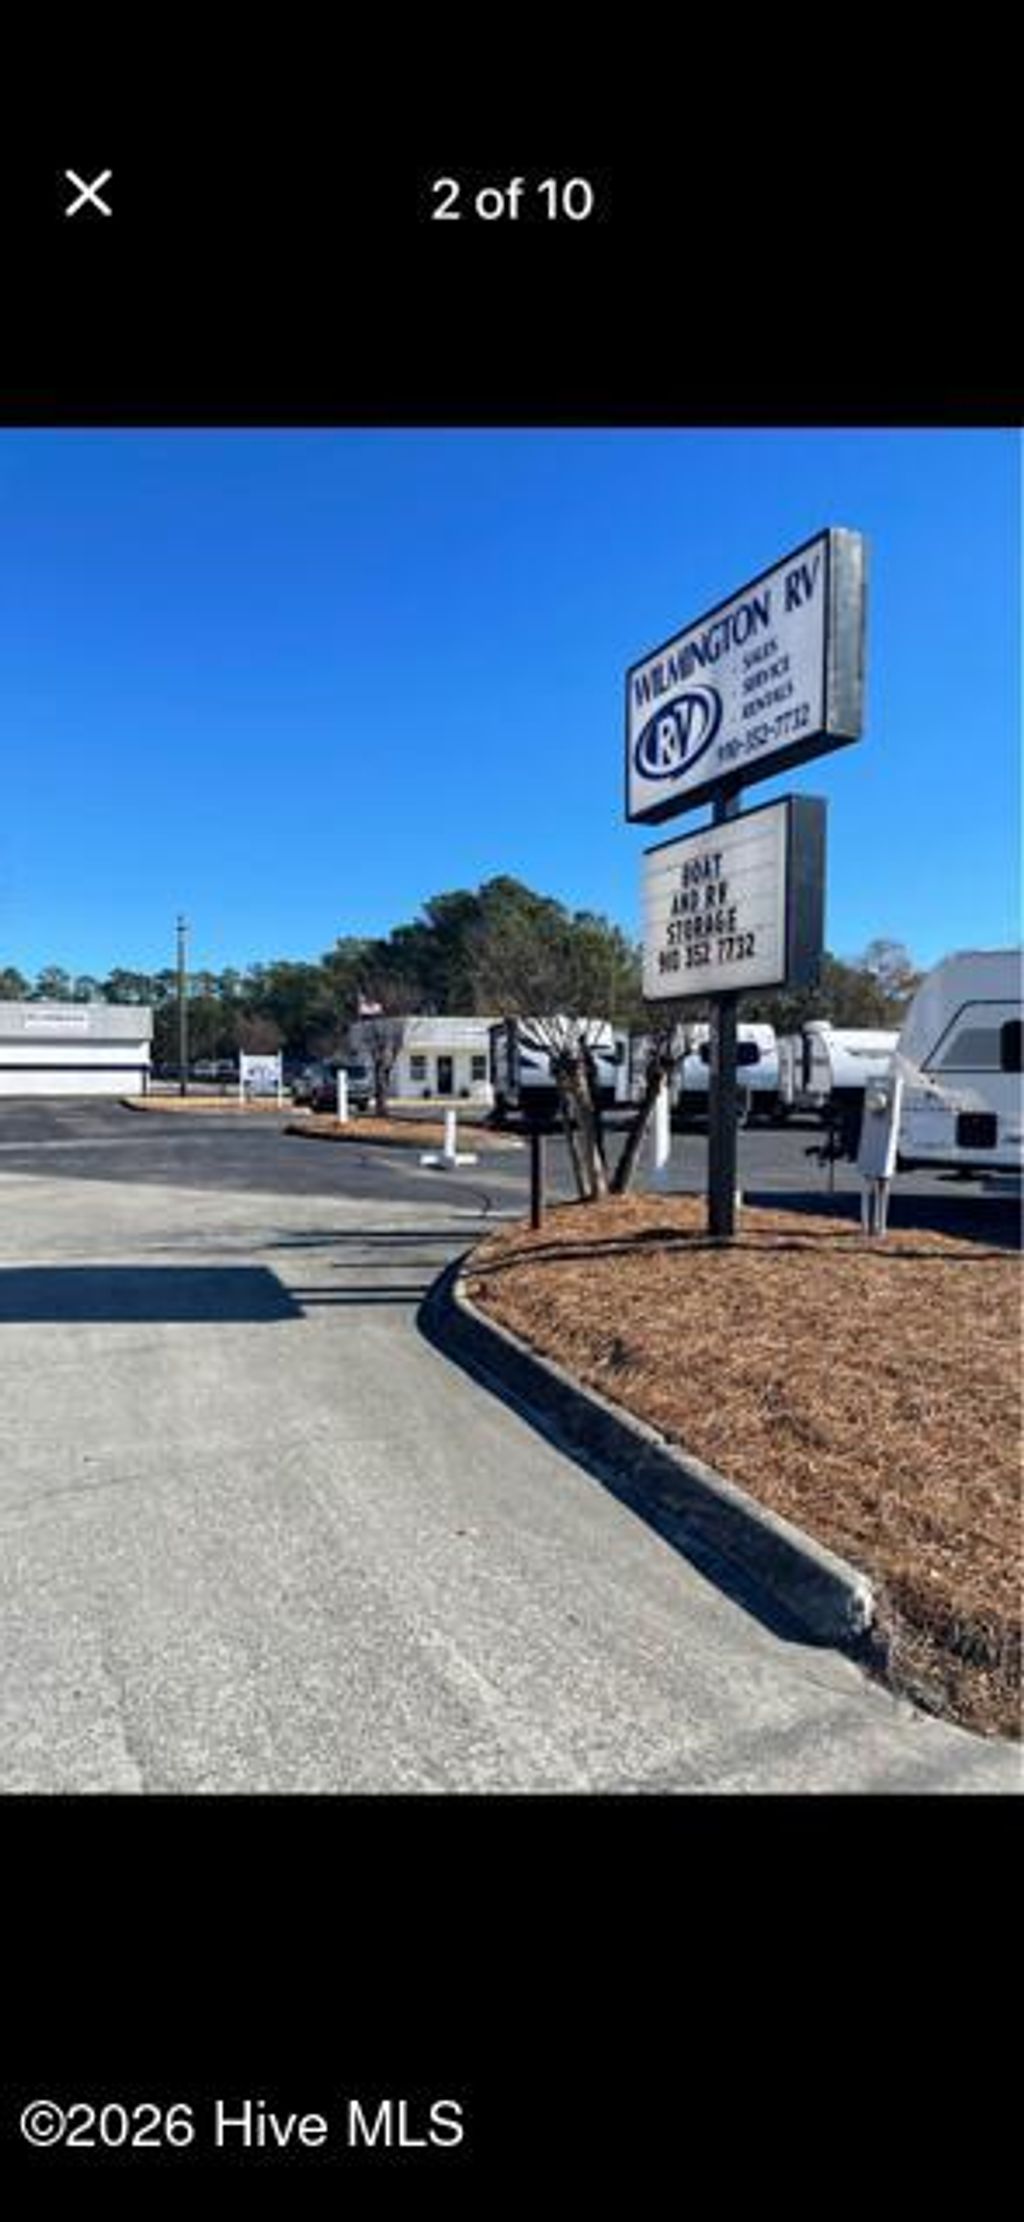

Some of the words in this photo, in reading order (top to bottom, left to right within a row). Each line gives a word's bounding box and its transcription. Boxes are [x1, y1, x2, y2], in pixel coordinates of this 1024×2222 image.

[635, 592, 771, 706] WILMINGTON
[784, 555, 820, 613] RV
[682, 853, 722, 889] BOAT
[671, 889, 698, 915] AND
[705, 880, 727, 908] RV
[666, 906, 737, 945] STORAGE
[685, 942, 710, 968] 352
[717, 933, 755, 965] 7732
